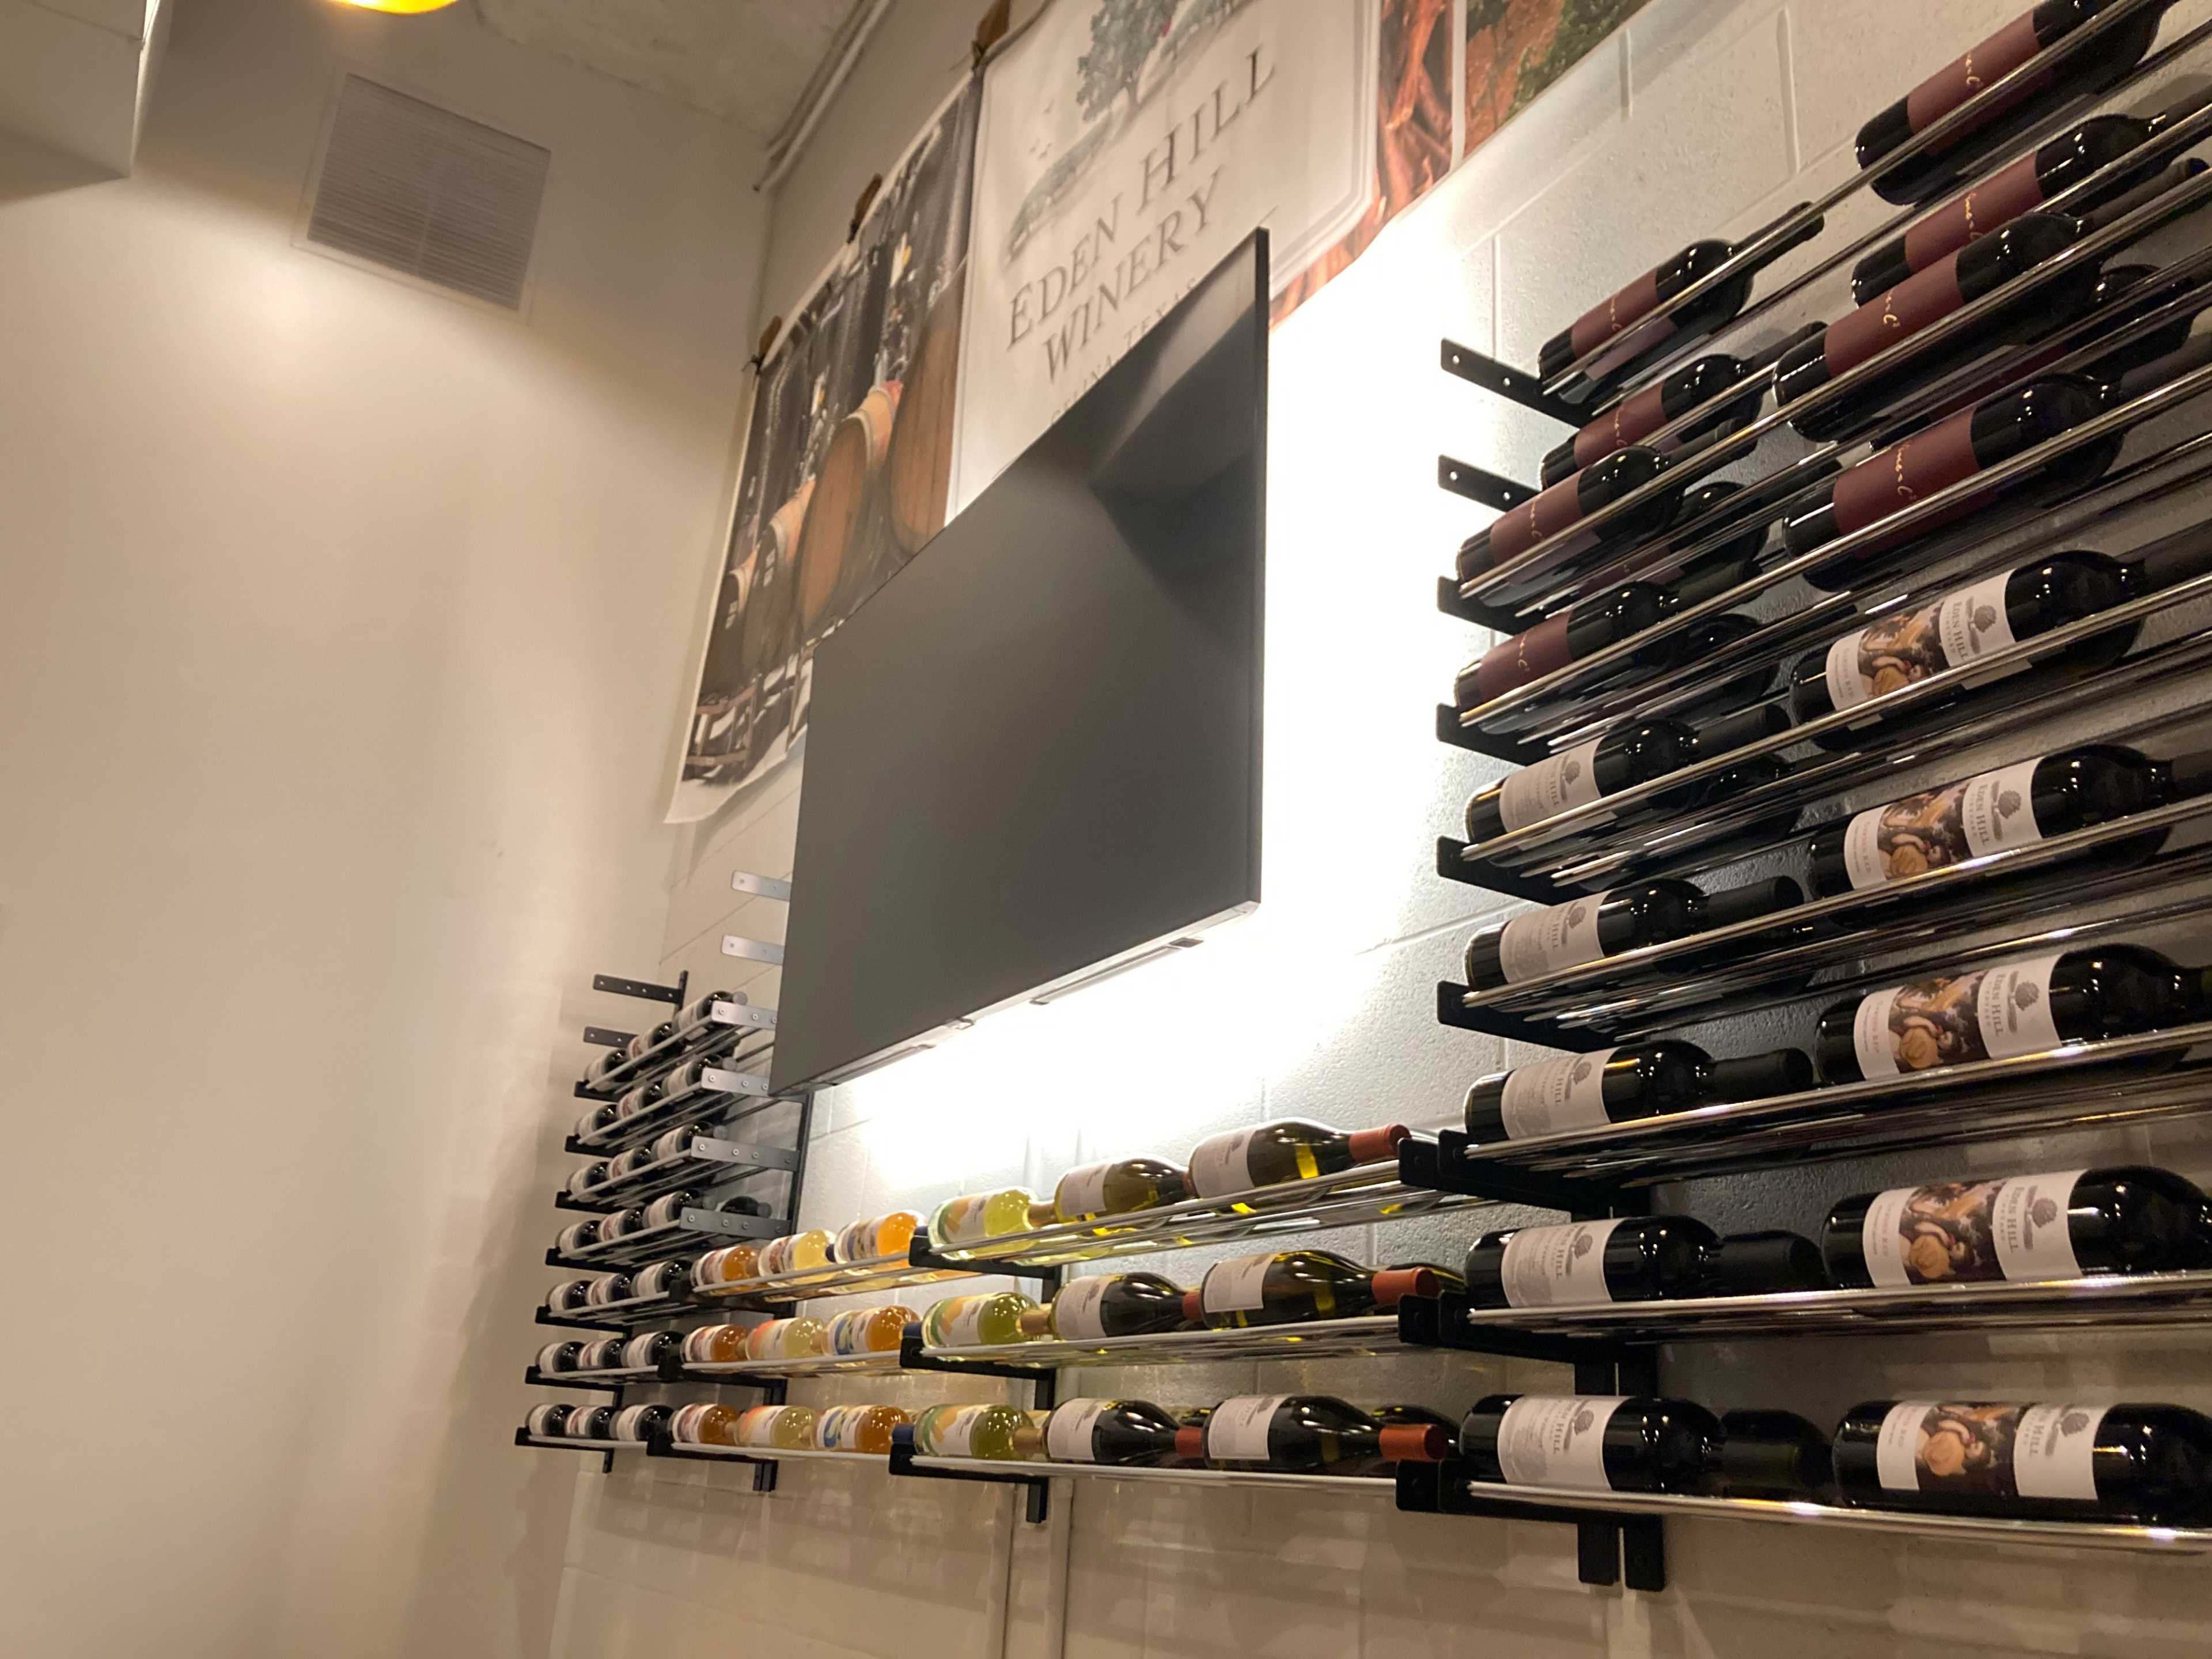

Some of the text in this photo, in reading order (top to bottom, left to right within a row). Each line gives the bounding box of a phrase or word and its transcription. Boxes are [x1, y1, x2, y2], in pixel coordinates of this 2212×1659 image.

[1007, 191, 1123, 351] EDEN
[1136, 44, 1275, 217] HILL
[1041, 164, 1226, 385] WINERY
[1953, 630, 1969, 661] HILL
[1976, 814, 1990, 847] HILL
[1991, 1004, 2004, 1036] HILL
[2007, 1218, 2019, 1254] HILL
[1555, 1249, 1565, 1280] HILL
[1553, 1423, 1565, 1455] HILL
